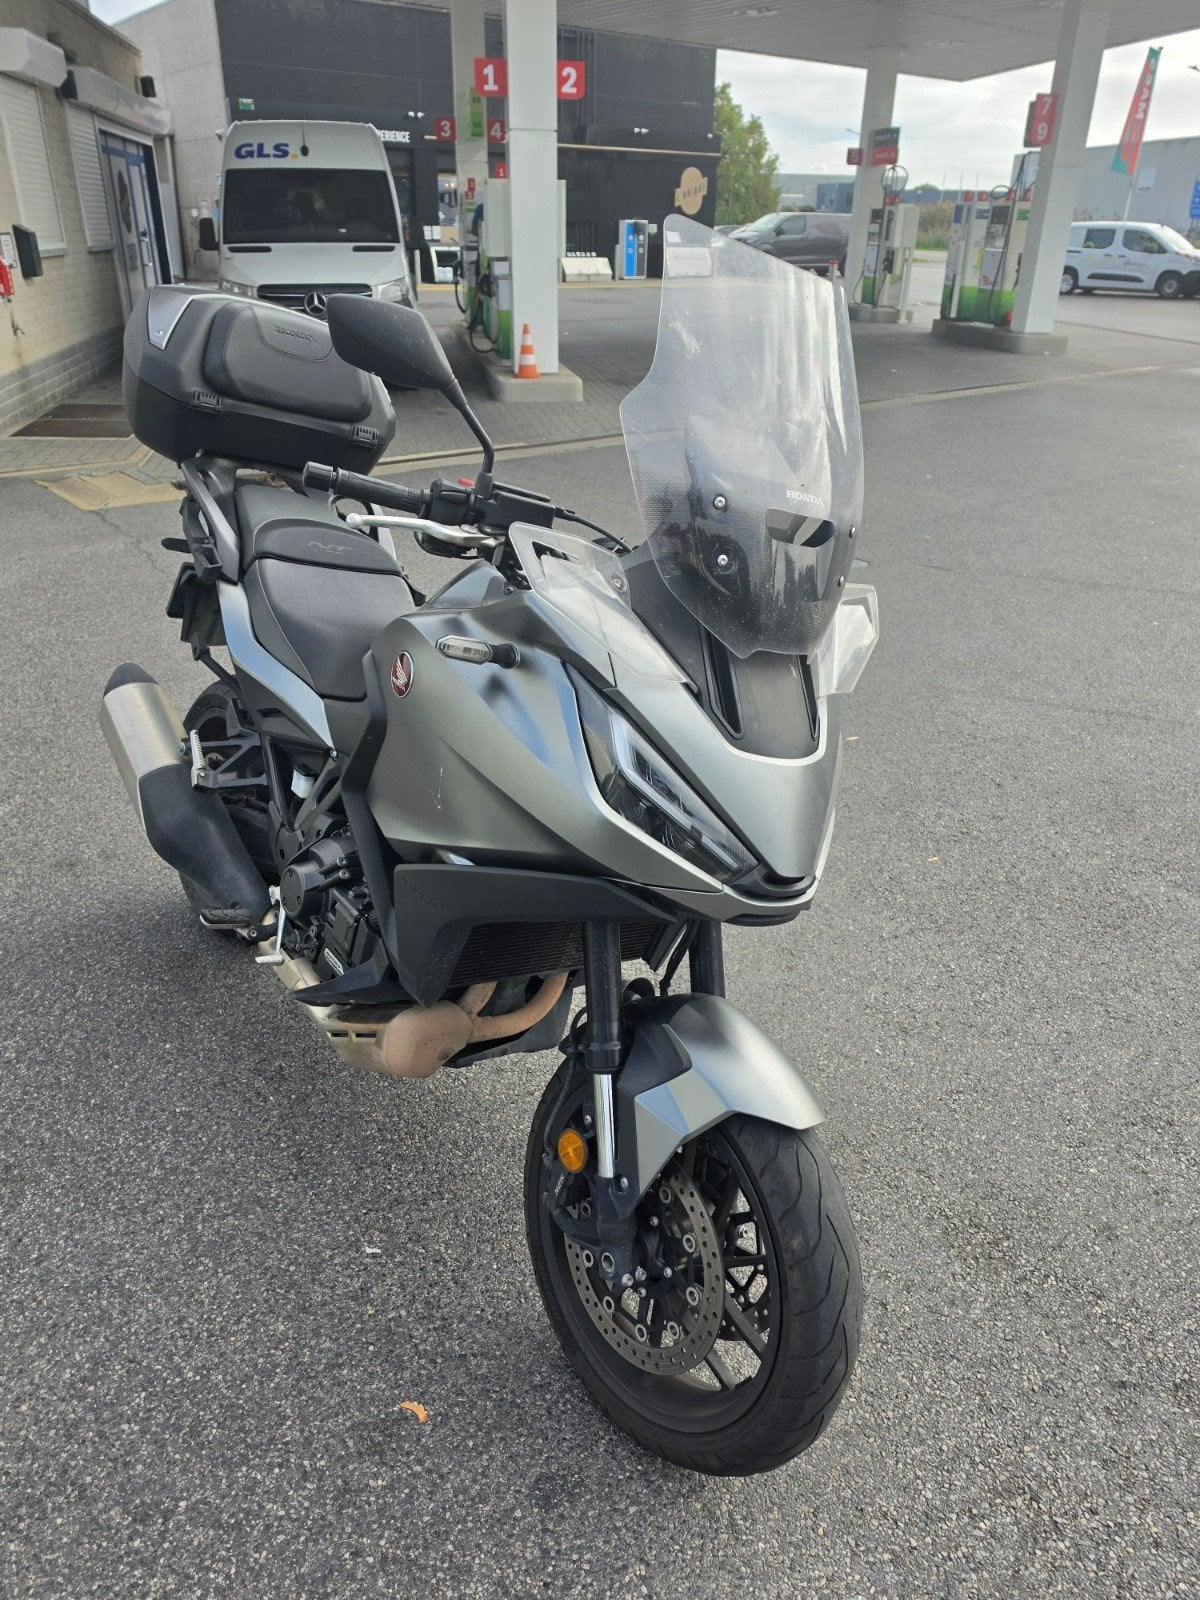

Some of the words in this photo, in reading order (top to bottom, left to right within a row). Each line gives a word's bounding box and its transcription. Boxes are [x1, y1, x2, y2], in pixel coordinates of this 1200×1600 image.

[483, 64, 499, 91] 1
[561, 66, 578, 93] 2
[1042, 97, 1053, 115] 7
[440, 120, 452, 138] 3
[490, 122, 502, 139] 4
[1036, 122, 1049, 141] 9
[785, 489, 825, 506] HONDA
